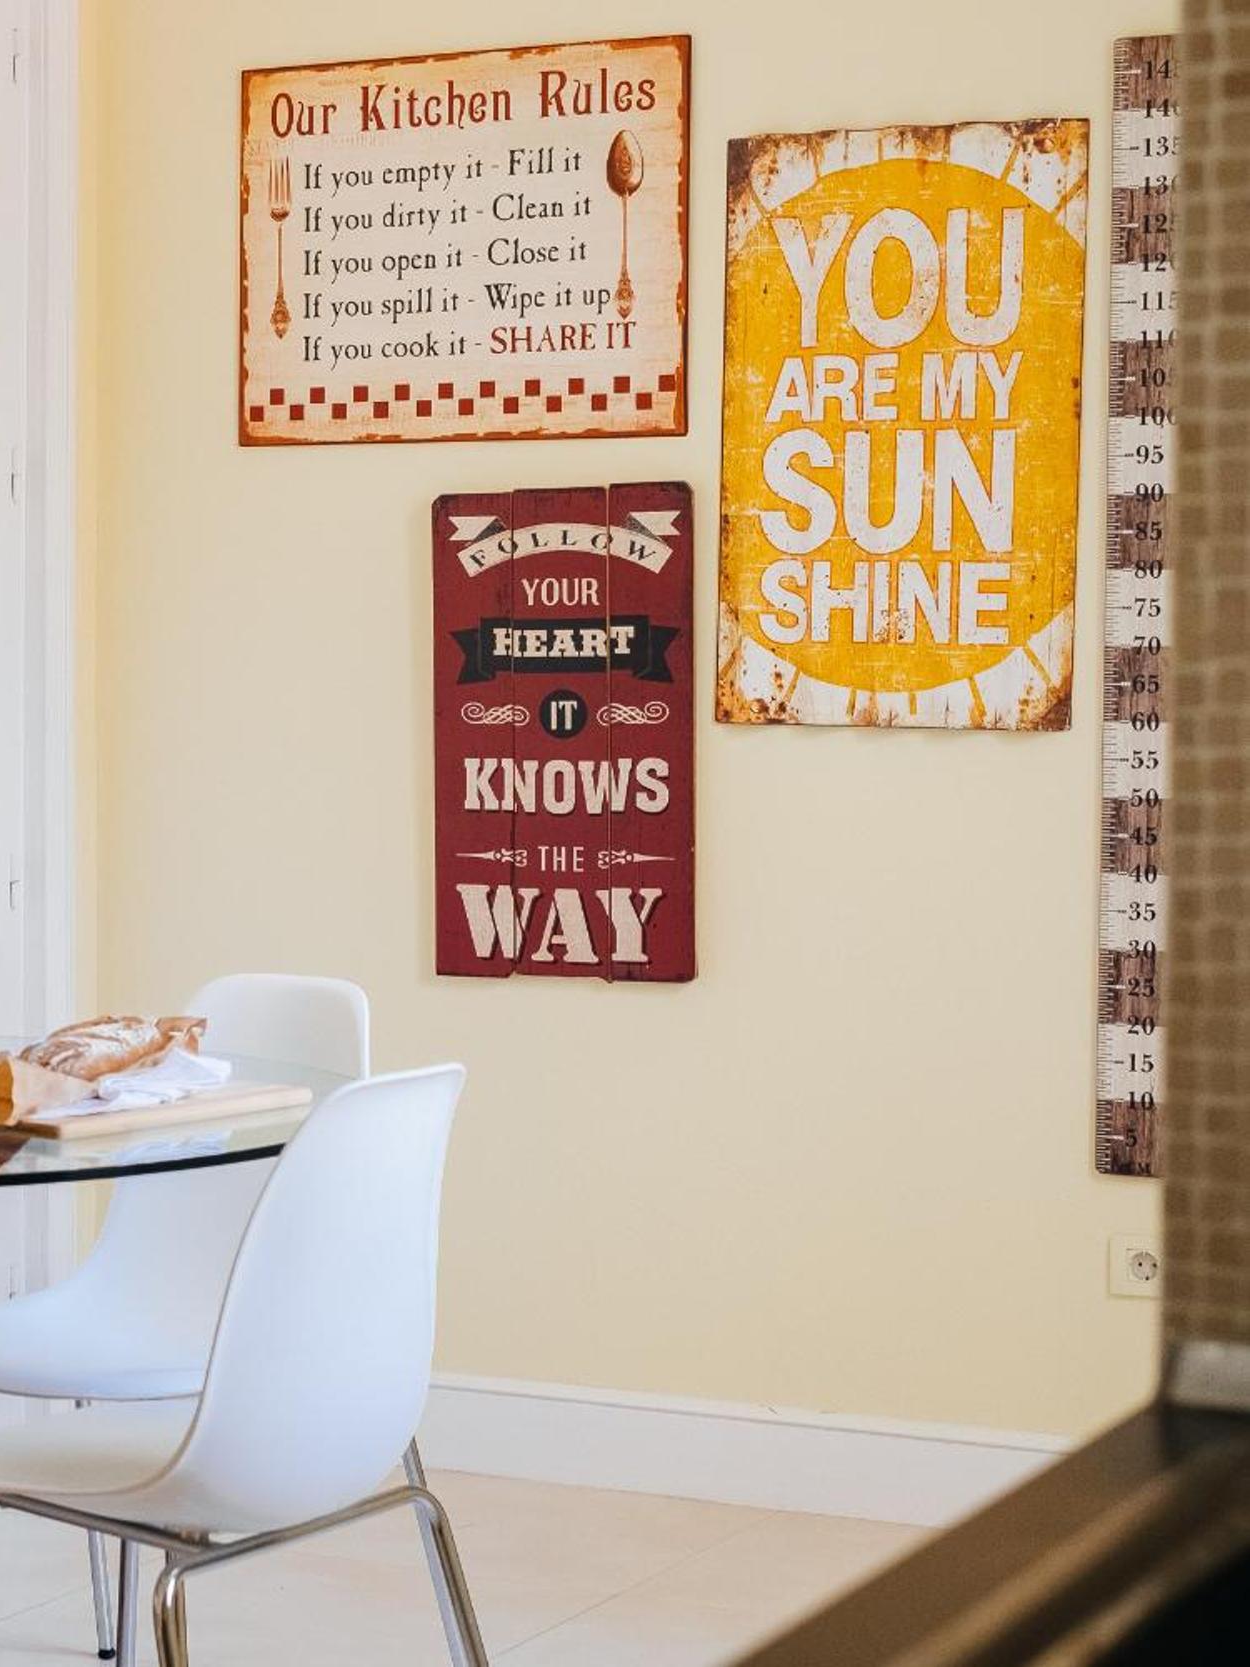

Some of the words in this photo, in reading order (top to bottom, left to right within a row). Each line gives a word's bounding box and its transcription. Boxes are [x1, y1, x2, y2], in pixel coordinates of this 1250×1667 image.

[1143, 59, 1178, 79] 14
[270, 93, 337, 138] Our
[360, 80, 511, 132] Kitchen
[539, 67, 656, 119] Rules
[304, 163, 322, 190] If
[332, 168, 373, 198] you
[383, 163, 455, 193] empty
[465, 154, 483, 179] it
[508, 147, 553, 176] Fill
[564, 149, 582, 172] it
[304, 207, 322, 233] If
[332, 211, 372, 240] you
[383, 201, 440, 237] dirty
[450, 199, 467, 224] it
[492, 193, 564, 222] Clean
[574, 191, 591, 216] it
[1143, 214, 1175, 233] 12
[303, 251, 322, 276] If
[331, 255, 372, 284] you
[382, 252, 436, 280] open
[447, 244, 463, 267] it
[487, 238, 559, 266] Close
[569, 238, 586, 261] it
[771, 207, 1025, 349] YOU
[303, 293, 322, 319] If
[331, 297, 372, 327] you
[381, 287, 432, 323] spill
[442, 287, 459, 312] it
[485, 284, 545, 320] Wipe
[555, 284, 572, 308] it
[582, 288, 611, 315] up
[303, 336, 321, 362] If
[331, 341, 372, 371] you
[381, 331, 438, 358] cook
[449, 330, 465, 356] it
[489, 322, 596, 354] SHARE
[606, 321, 637, 349] IT
[765, 352, 898, 423] ARE
[921, 350, 1023, 422] MY
[1140, 368, 1174, 387] 10
[1136, 445, 1164, 464] 95
[759, 427, 1015, 555] SUN
[1136, 483, 1164, 502] 90
[1135, 521, 1162, 540] 85
[469, 529, 656, 568] FOLLOW
[1135, 560, 1162, 579] 80
[521, 578, 600, 606] YOUR
[758, 559, 1012, 645] SHINE
[1134, 598, 1160, 617] 75
[493, 626, 634, 658] HEART
[1134, 636, 1160, 655] 70
[1133, 675, 1159, 694] 65
[551, 700, 577, 730] IT
[1132, 711, 1159, 732] 60
[1131, 750, 1158, 769] 55
[464, 758, 670, 814] KNOWS
[1131, 788, 1158, 808] 50
[1130, 827, 1157, 845] 45
[538, 846, 584, 873] THE
[1130, 864, 1157, 883] 40
[1129, 902, 1156, 921] 35
[456, 884, 662, 963] WAY
[1129, 940, 1156, 959] 30
[1128, 978, 1155, 997] 25
[1128, 1016, 1155, 1035] 20
[1129, 1053, 1154, 1072] 15
[1128, 1091, 1154, 1111] 10
[1125, 1129, 1137, 1147] 5
